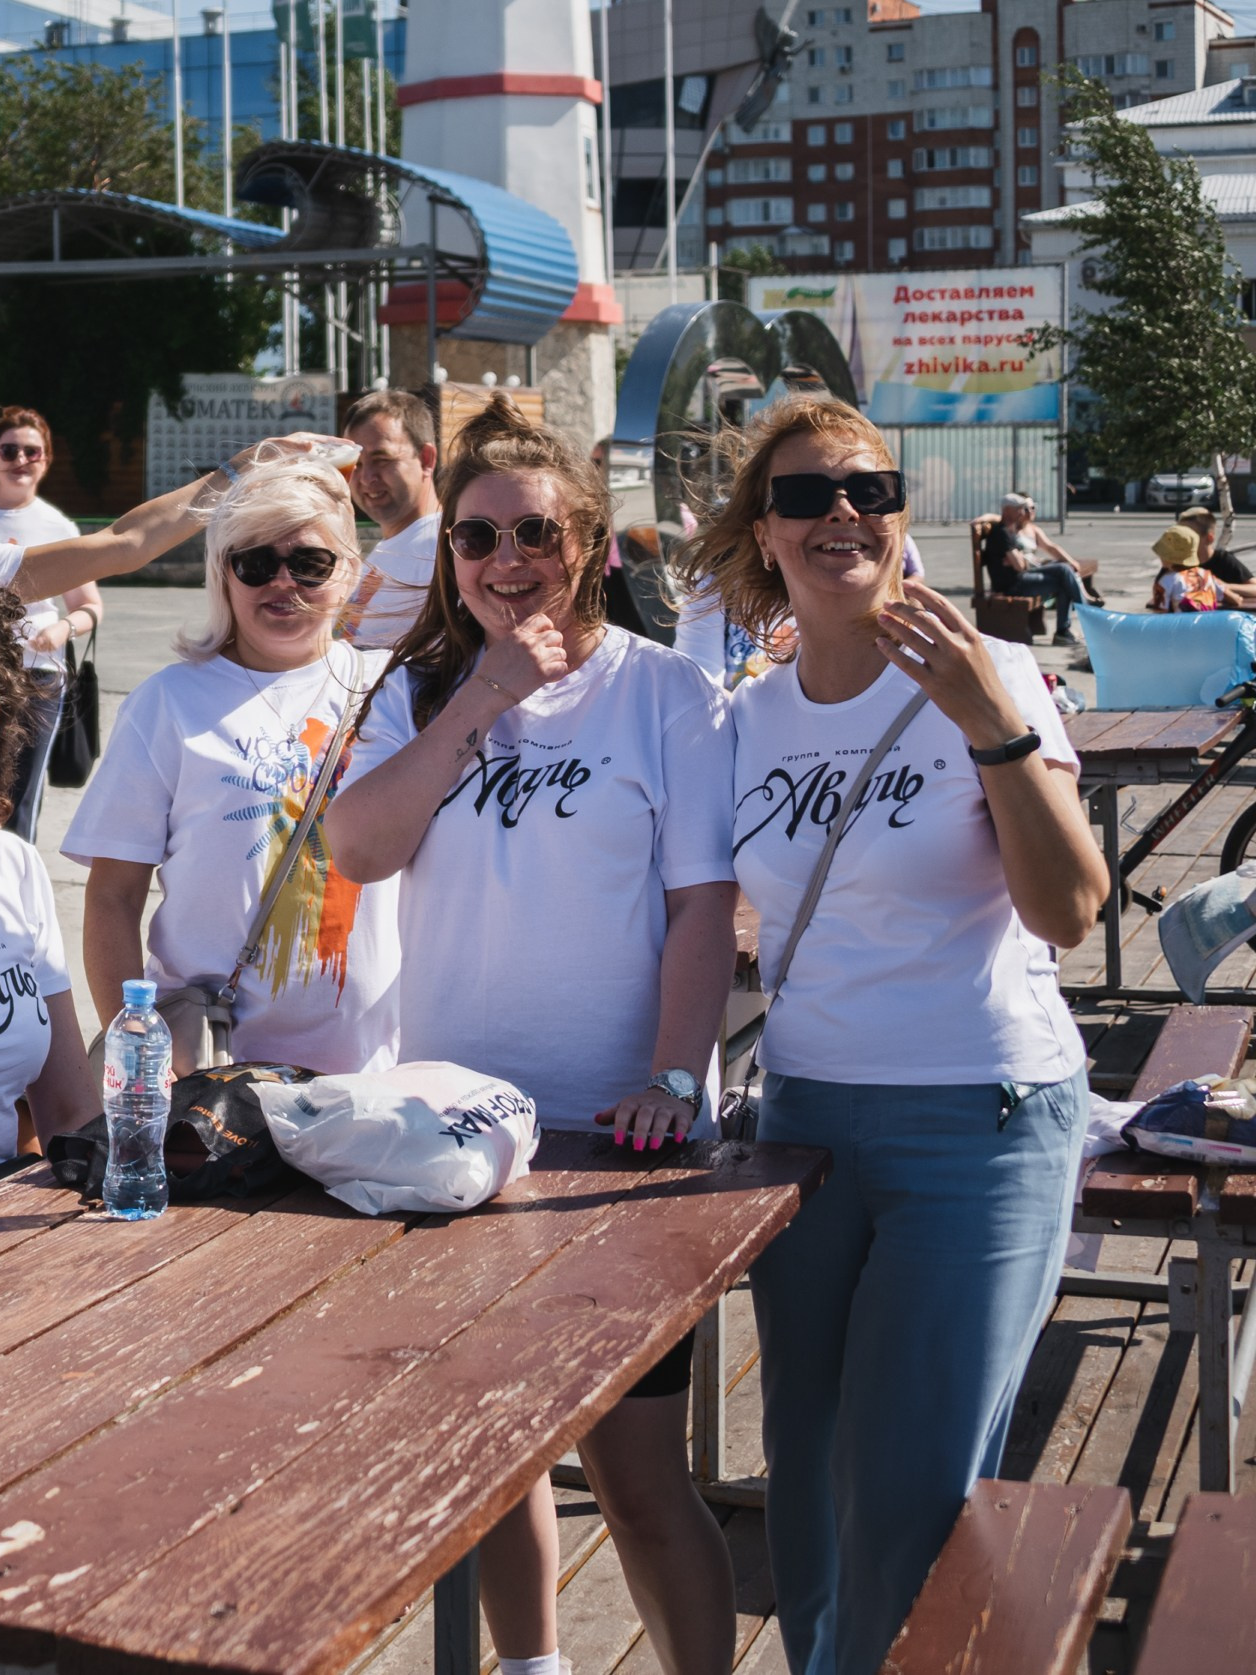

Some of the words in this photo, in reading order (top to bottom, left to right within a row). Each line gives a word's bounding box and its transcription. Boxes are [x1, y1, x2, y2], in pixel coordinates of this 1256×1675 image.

[893, 284, 1035, 304] Доставляем
[902, 308, 1025, 327] лекарства
[892, 336, 913, 347] на
[918, 335, 956, 346] всех
[904, 355, 1025, 375] zhivika.ru
[169, 397, 277, 420] ОМАТЕК
[782, 751, 820, 762] группа
